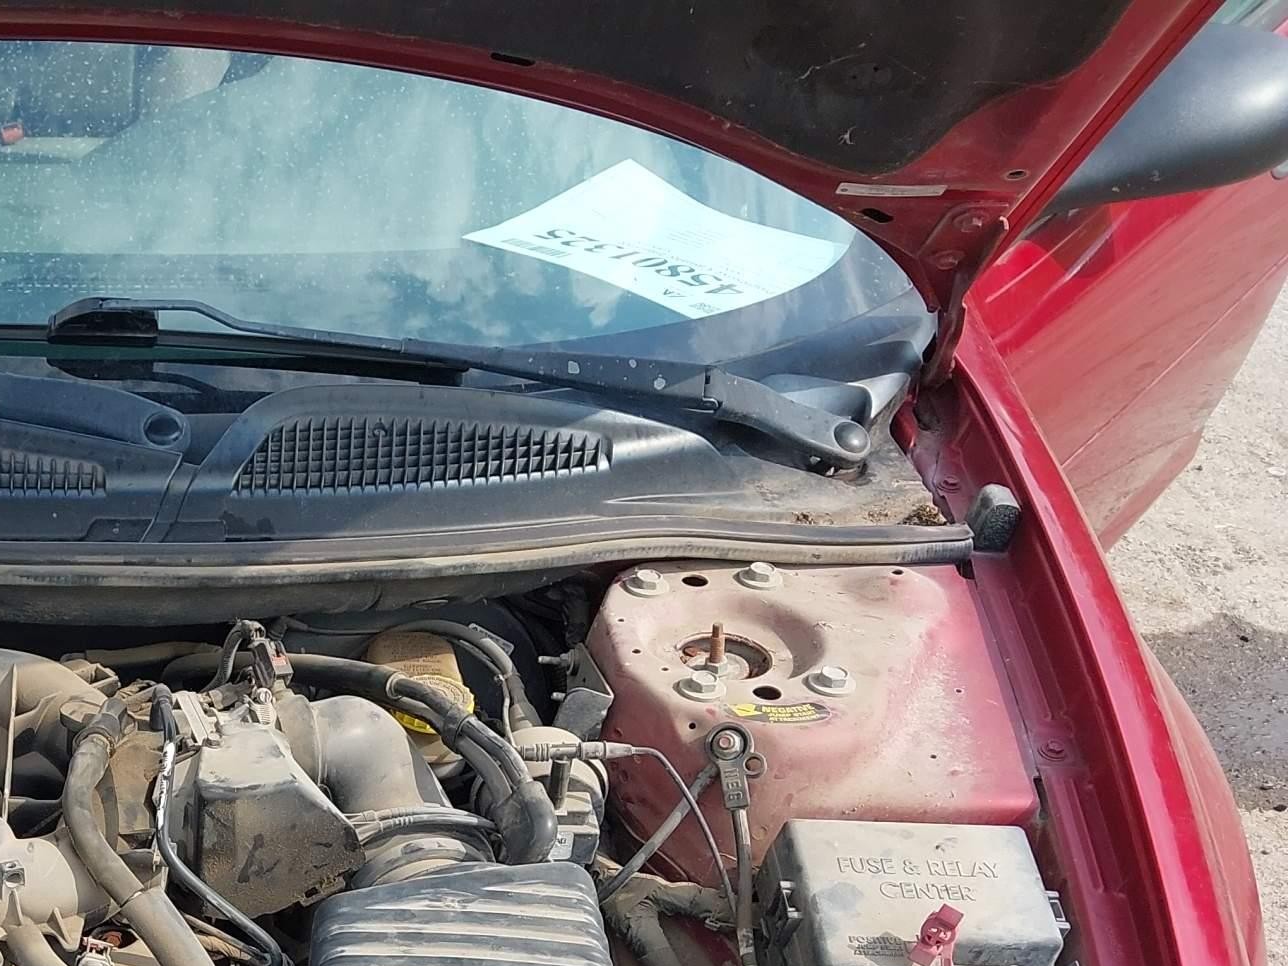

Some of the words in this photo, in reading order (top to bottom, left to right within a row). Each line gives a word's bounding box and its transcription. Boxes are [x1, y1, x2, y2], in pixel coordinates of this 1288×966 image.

[534, 228, 744, 296] 45801325
[836, 857, 896, 874] FUSE
[903, 859, 921, 875] &
[927, 859, 999, 879] RELAY
[879, 881, 977, 901] CENTER
